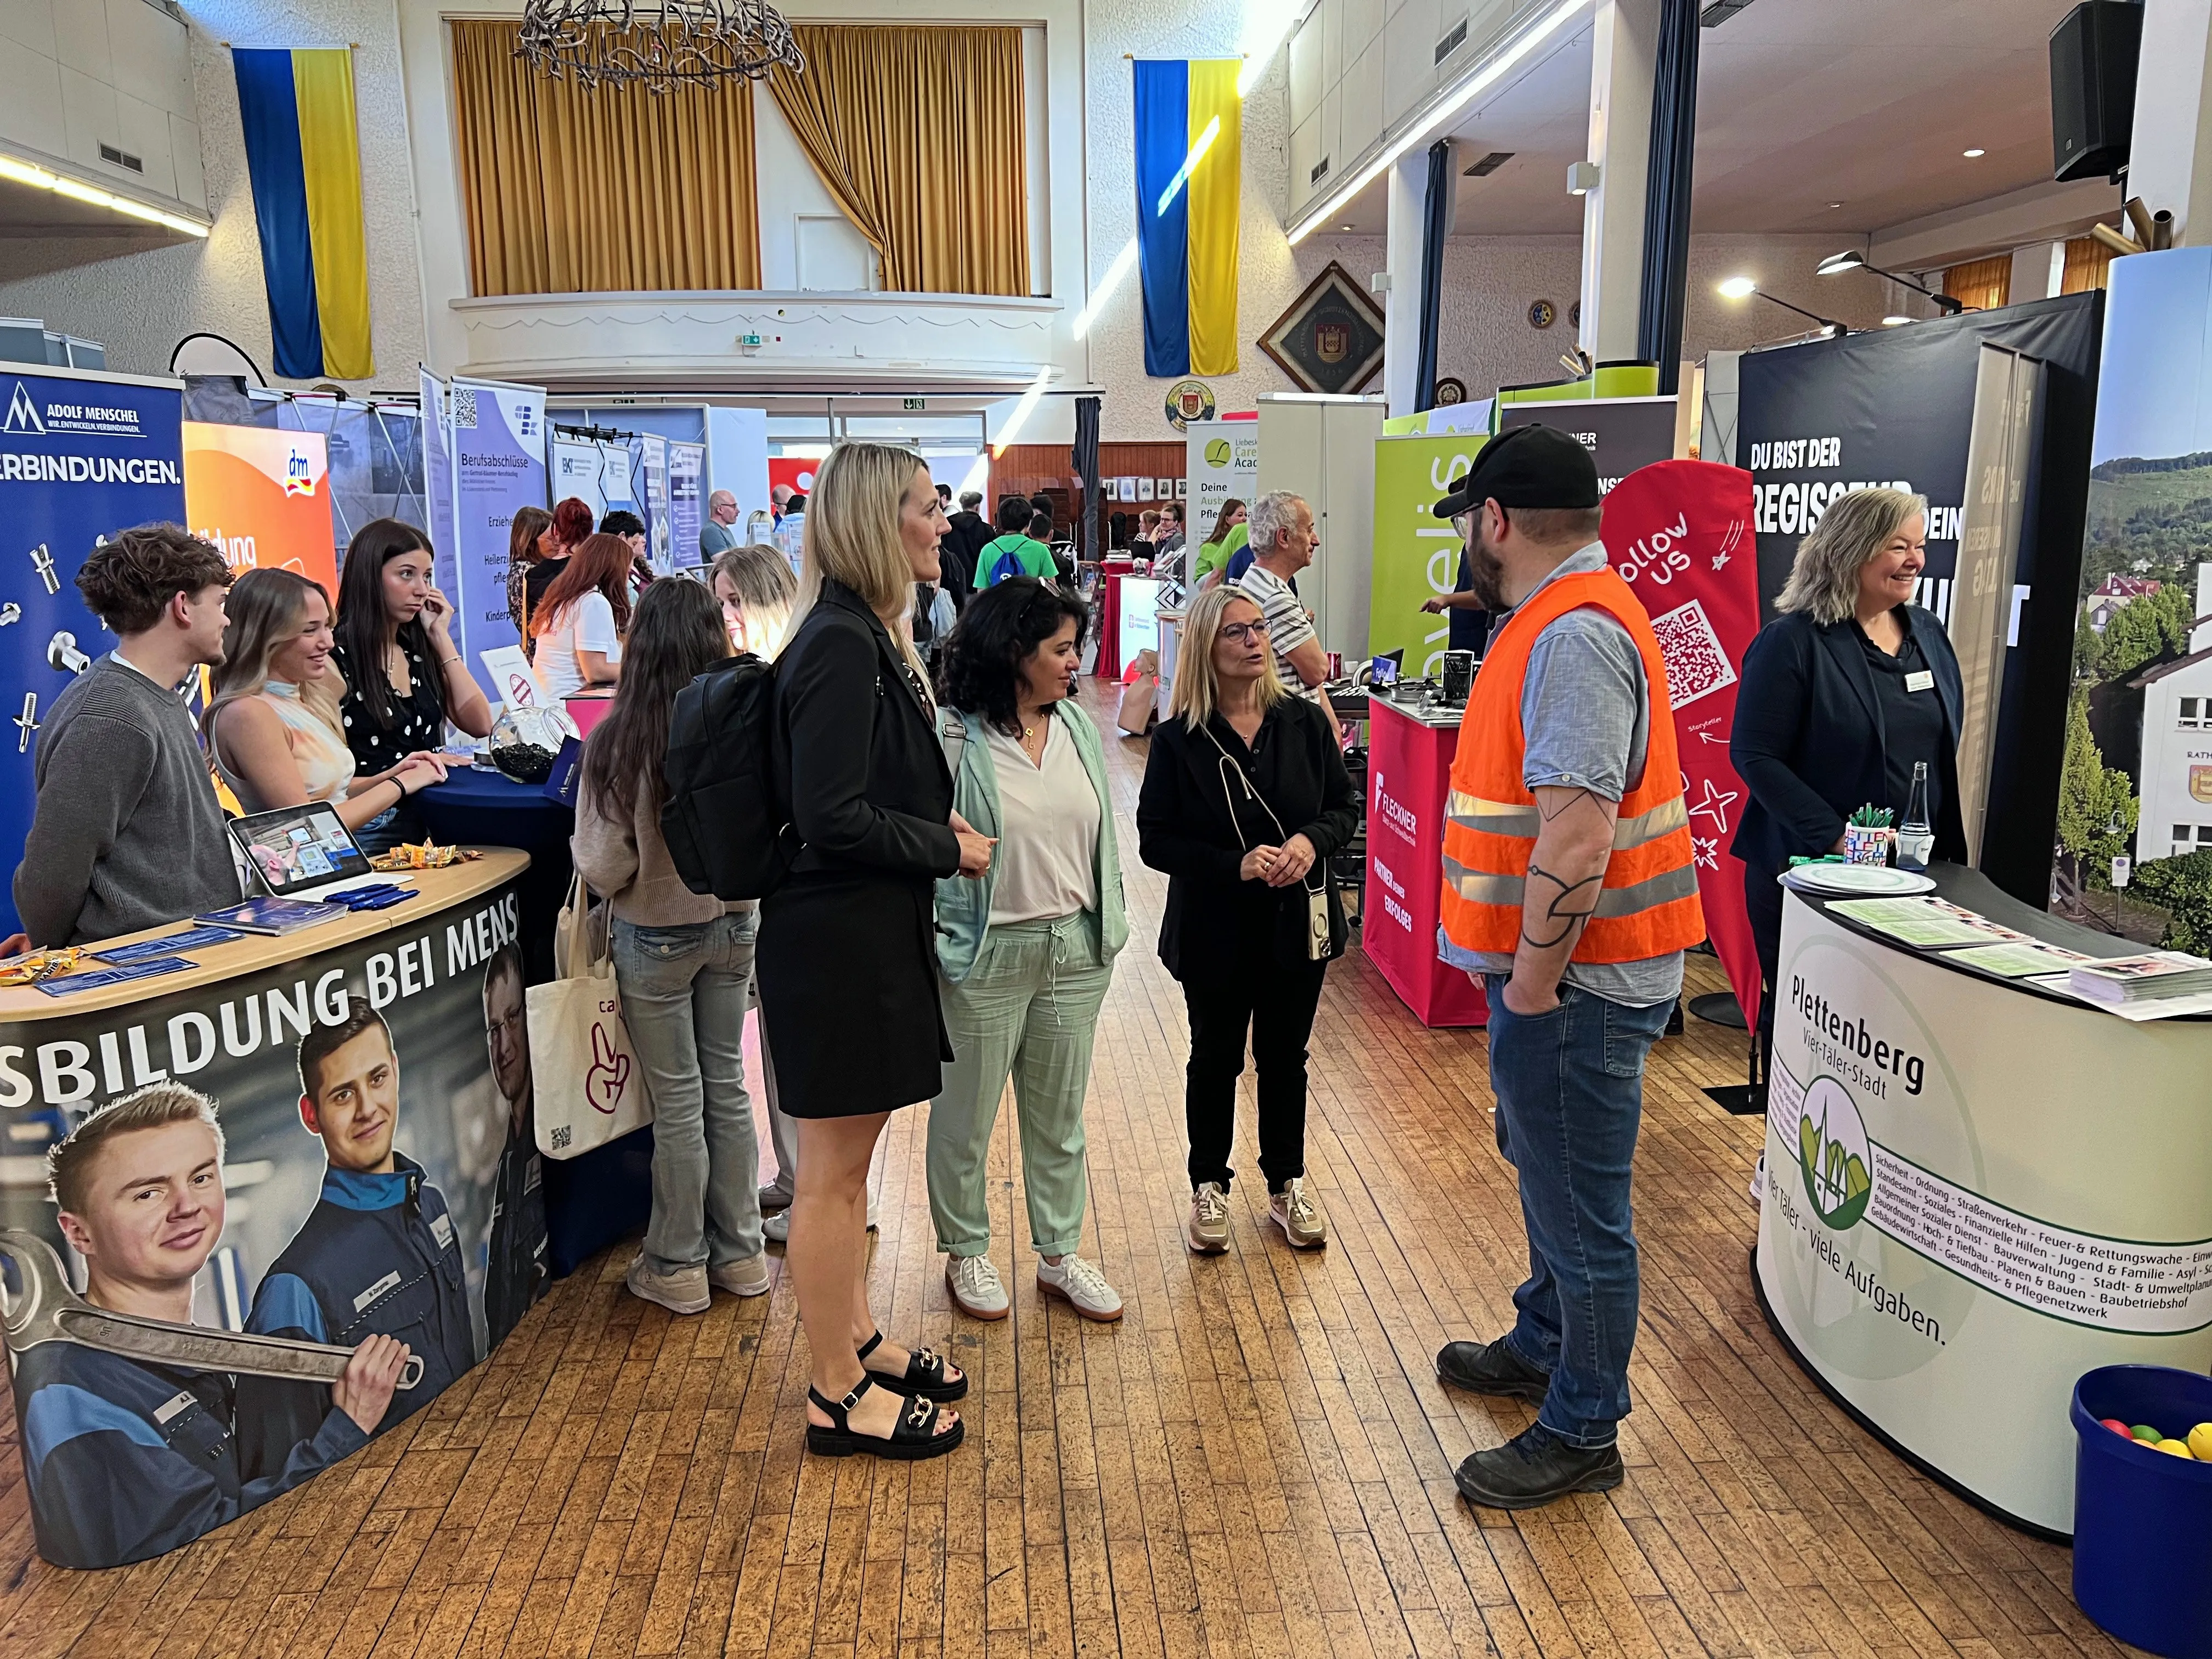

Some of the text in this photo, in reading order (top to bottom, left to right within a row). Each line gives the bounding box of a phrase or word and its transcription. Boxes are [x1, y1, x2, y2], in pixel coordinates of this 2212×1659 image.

[47, 404, 139, 423] ADOLF MENSCHEL
[0, 453, 180, 484] RBINDUNGEN.
[290, 449, 308, 476] dm
[462, 453, 529, 468] Berufsabschlüsse
[1235, 448, 1256, 456] Care
[1751, 437, 1841, 470] DU BIST DER
[1201, 483, 1227, 492] Deine
[1688, 717, 1722, 732] Storyteller
[1383, 793, 1416, 835] FLECKNER
[1384, 894, 1412, 933] ERFOLGES
[366, 935, 435, 1010] BEI
[447, 888, 520, 977] MENS
[1792, 975, 1924, 1096] Plettenberg
[1803, 1026, 1886, 1100] Vier-Täler-Stadt
[1876, 1154, 1908, 1180] Sicherheit
[1916, 1177, 1949, 1202] Ordnung
[1957, 1198, 2028, 1235] Straßenverkehr
[2090, 1246, 2182, 1265] Rettungswache
[1876, 1169, 1916, 1198] Standesamt
[1925, 1195, 1956, 1218] Soziales
[1965, 1215, 2013, 1245] Finanzielle
[2016, 1239, 2047, 1258] Hilfen
[2058, 1254, 2103, 1273] Jugend
[2108, 1265, 2117, 1275] &
[2121, 1267, 2164, 1279] Familie
[2176, 1267, 2197, 1280] Asyl
[1874, 1194, 1915, 1227] Bauordnung
[1923, 1223, 1944, 1240] Hoch-
[1947, 1235, 1953, 1245] &
[1956, 1240, 1988, 1263] Tiefbau
[1997, 1260, 2031, 1283] Planen
[2035, 1276, 2044, 1286] &
[2047, 1280, 2086, 1299] Bauen
[2100, 1294, 2188, 1309] Baubetriebshof
[1877, 1183, 1919, 1214] Allgemeiner
[1922, 1208, 1952, 1231] Sozialer
[1955, 1225, 1981, 1245] Dienst
[1994, 1244, 2075, 1283] Bauverwaltung
[2094, 1277, 2130, 1291] Stadt-
[2135, 1284, 2143, 1293] &
[1780, 1186, 1799, 1231] Täler
[1810, 1228, 1841, 1273] viele
[1844, 1261, 1945, 1346] Aufgaben.
[1871, 1206, 1937, 1252] Gebäudewirtschaft
[1945, 1249, 2001, 1283] Gesundheits-
[2005, 1278, 2012, 1289] &
[2015, 1283, 2108, 1318] Pflegenetzwerk
